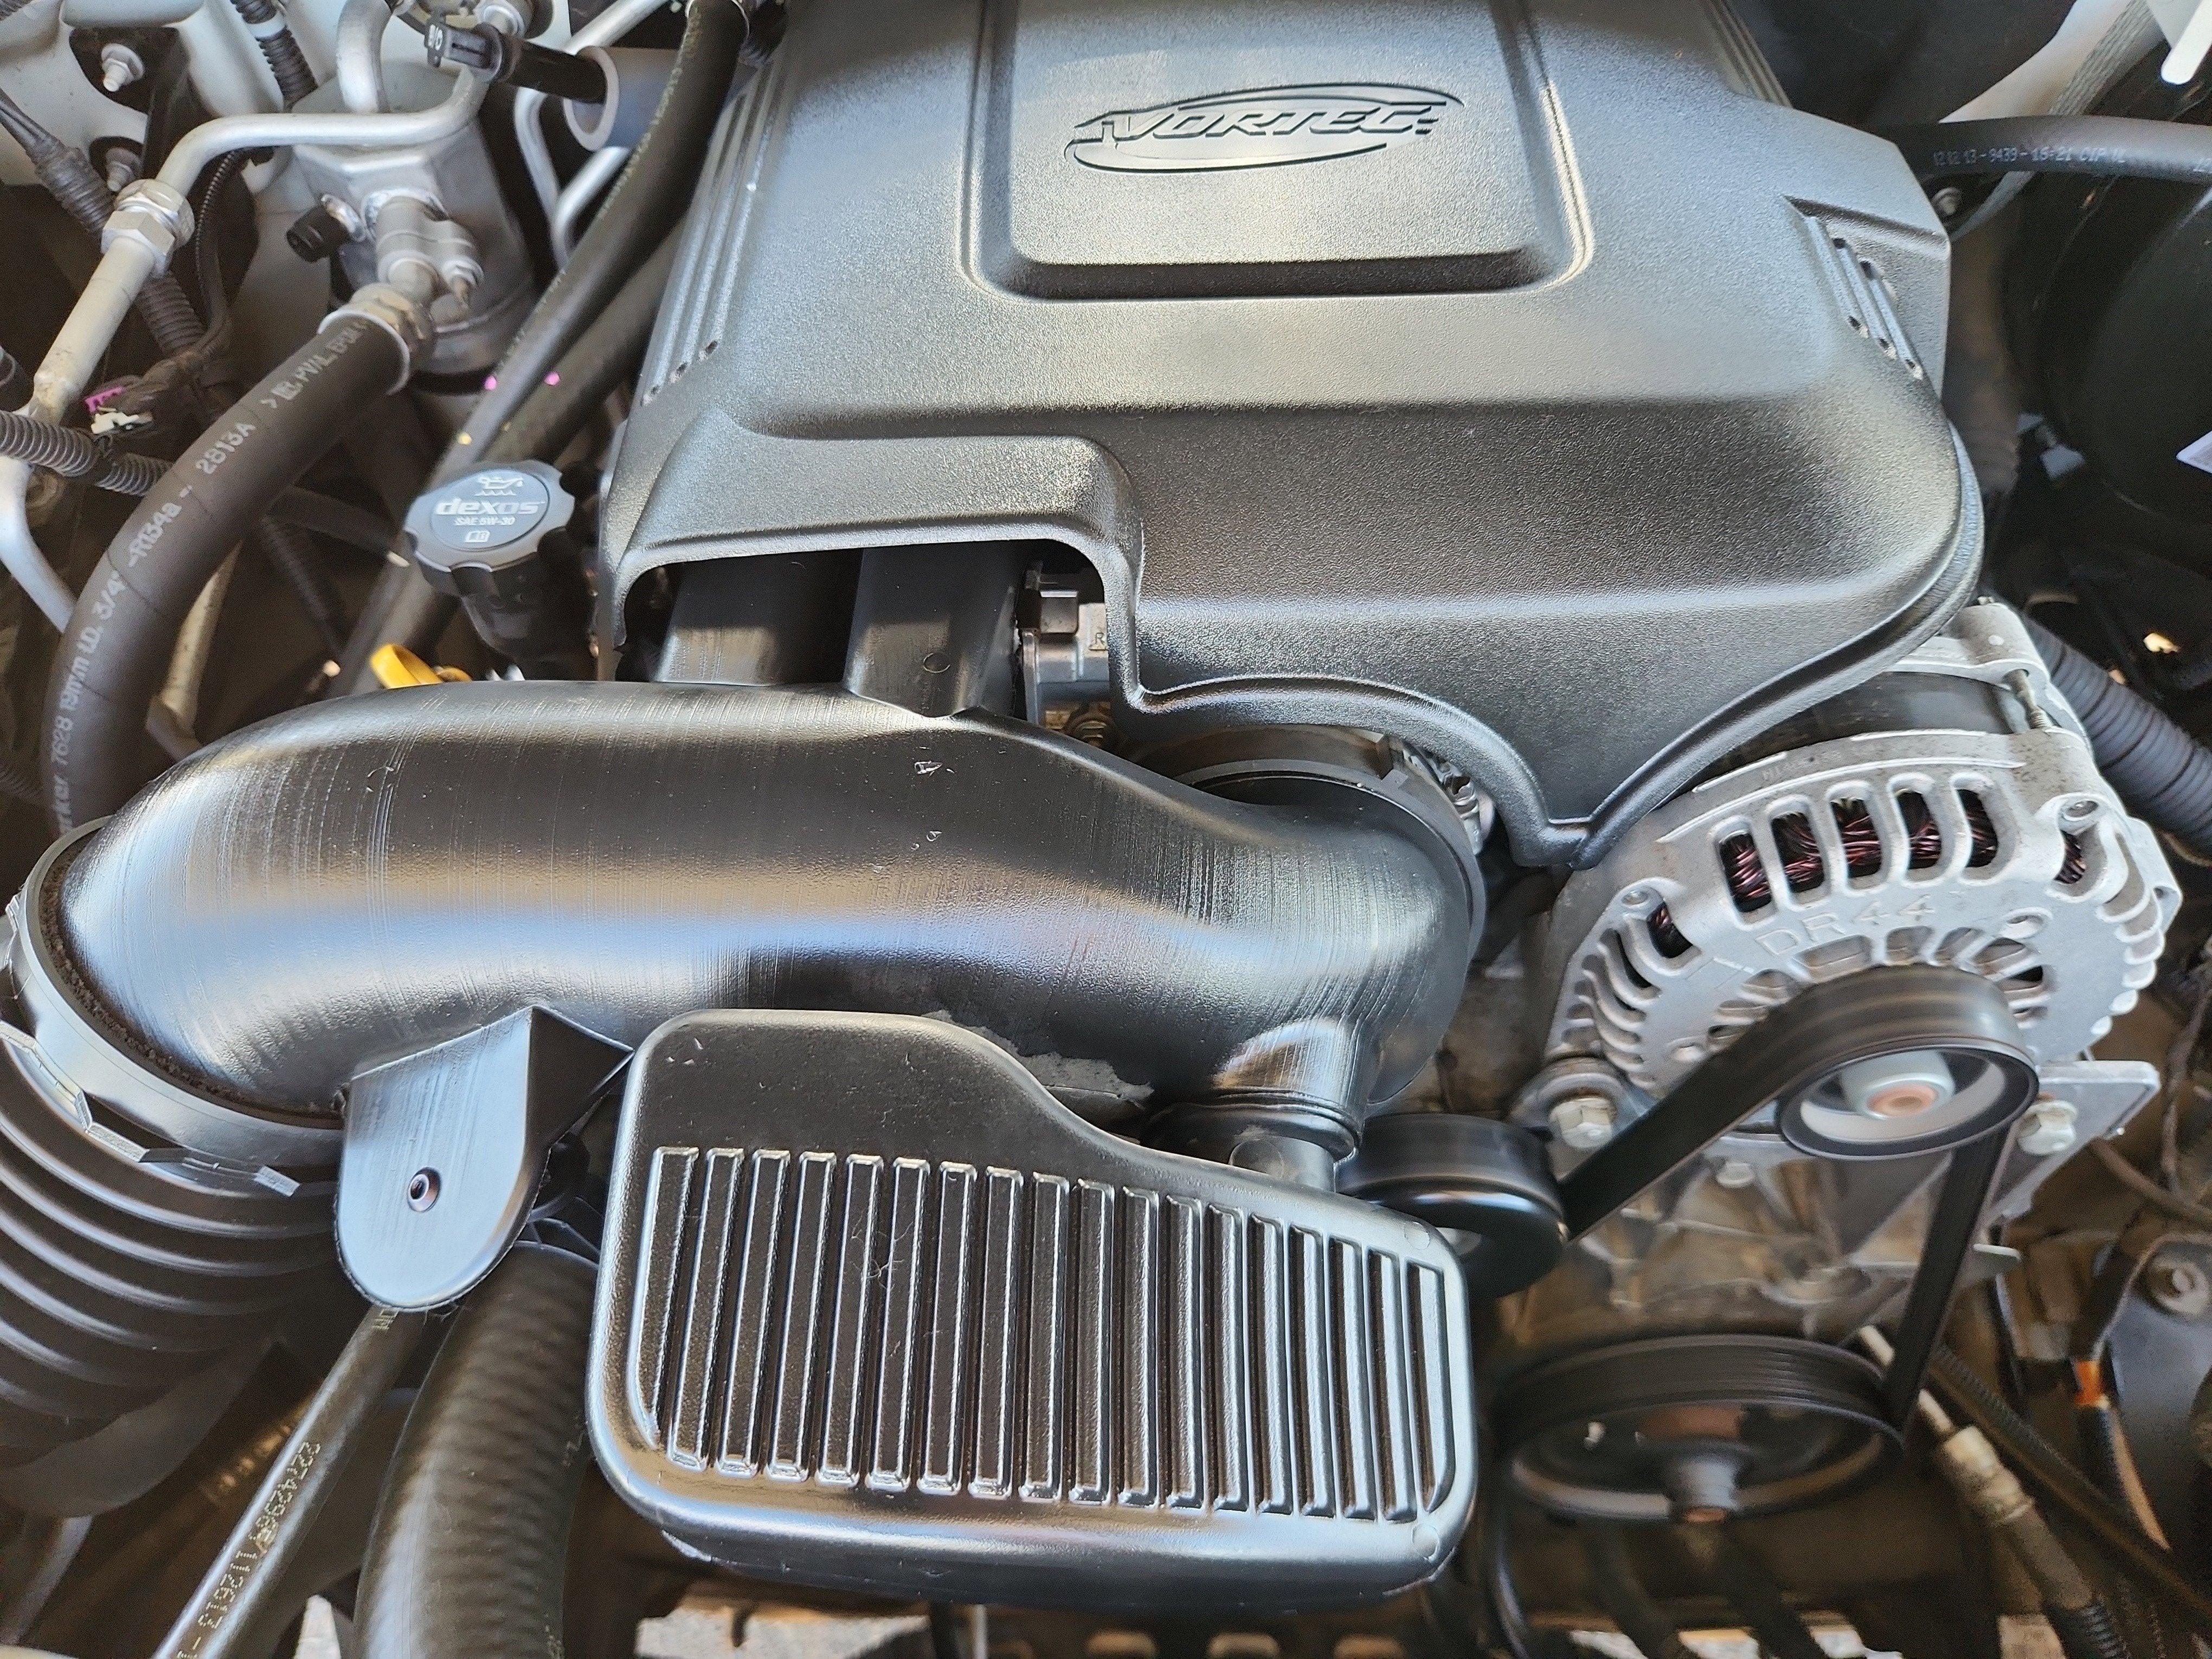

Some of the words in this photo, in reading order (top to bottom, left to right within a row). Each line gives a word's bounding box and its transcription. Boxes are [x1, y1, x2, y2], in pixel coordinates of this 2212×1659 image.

[1103, 101, 1434, 143] VORTEC
[435, 497, 539, 515] dexos
[454, 517, 478, 526] SAE
[479, 517, 516, 526] 5W-30
[50, 715, 74, 766] 7628
[195, 422, 256, 474] 2813A
